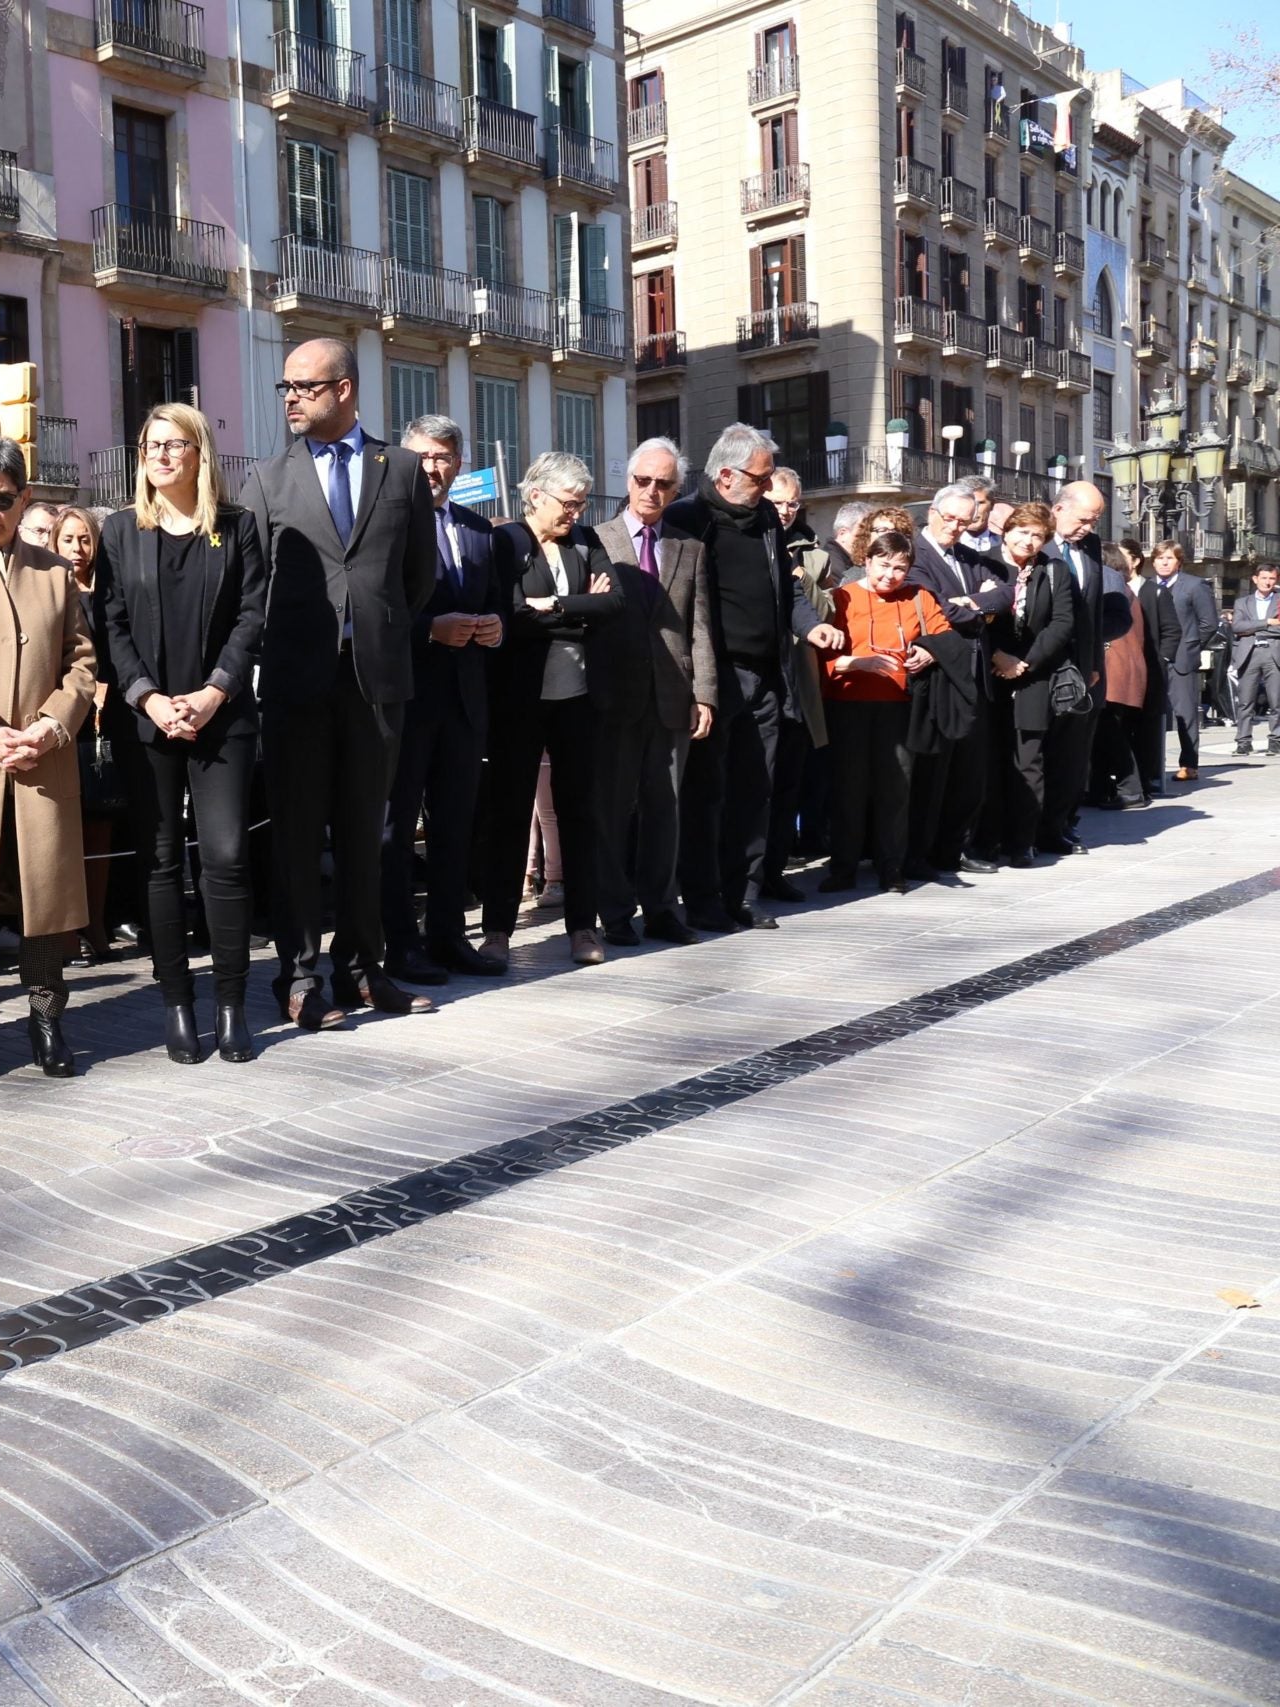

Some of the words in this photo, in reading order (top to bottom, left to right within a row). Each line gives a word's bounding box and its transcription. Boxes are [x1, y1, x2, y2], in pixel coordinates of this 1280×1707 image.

[217, 418, 226, 430] 71
[647, 1098, 718, 1124] OH
[498, 1118, 660, 1180] CIUDAD
[221, 1227, 309, 1257] DE
[309, 1188, 410, 1226] PAU
[429, 1142, 535, 1182] QUE
[520, 1123, 590, 1149] LA
[574, 1097, 660, 1129] PAZ
[425, 1178, 508, 1207] DE
[323, 1204, 435, 1246] PAZ
[80, 1256, 292, 1328] PEACE
